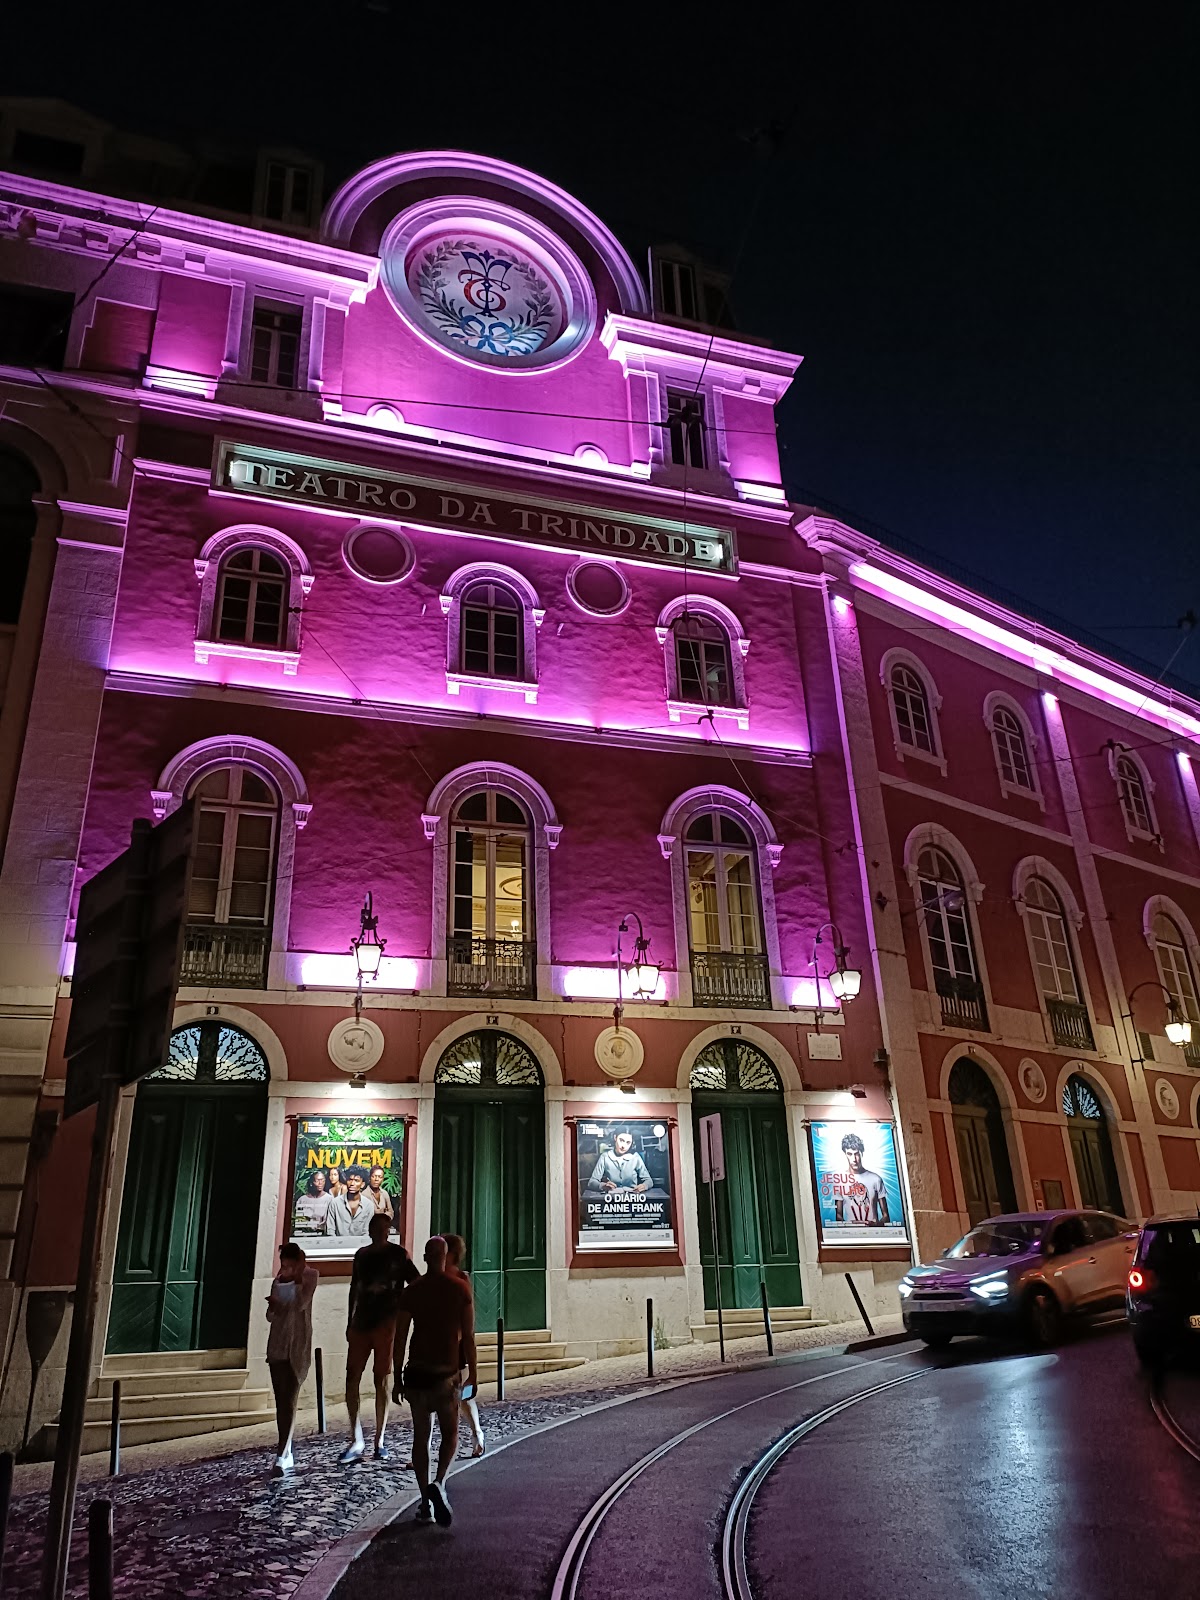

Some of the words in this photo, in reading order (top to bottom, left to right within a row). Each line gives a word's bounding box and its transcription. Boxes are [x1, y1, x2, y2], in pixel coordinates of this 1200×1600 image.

[232, 459, 417, 511] TEATRO
[439, 495, 497, 526] DA
[511, 508, 717, 562] TRINDADE
[307, 1149, 392, 1168] NUVEM
[821, 1185, 830, 1196] O
[833, 1184, 866, 1196] FILHO
[604, 1193, 612, 1202] O
[614, 1191, 645, 1202] DIÁRIO
[587, 1204, 602, 1213] DE
[603, 1204, 630, 1213] ANNE
[631, 1203, 664, 1213] FRANK
